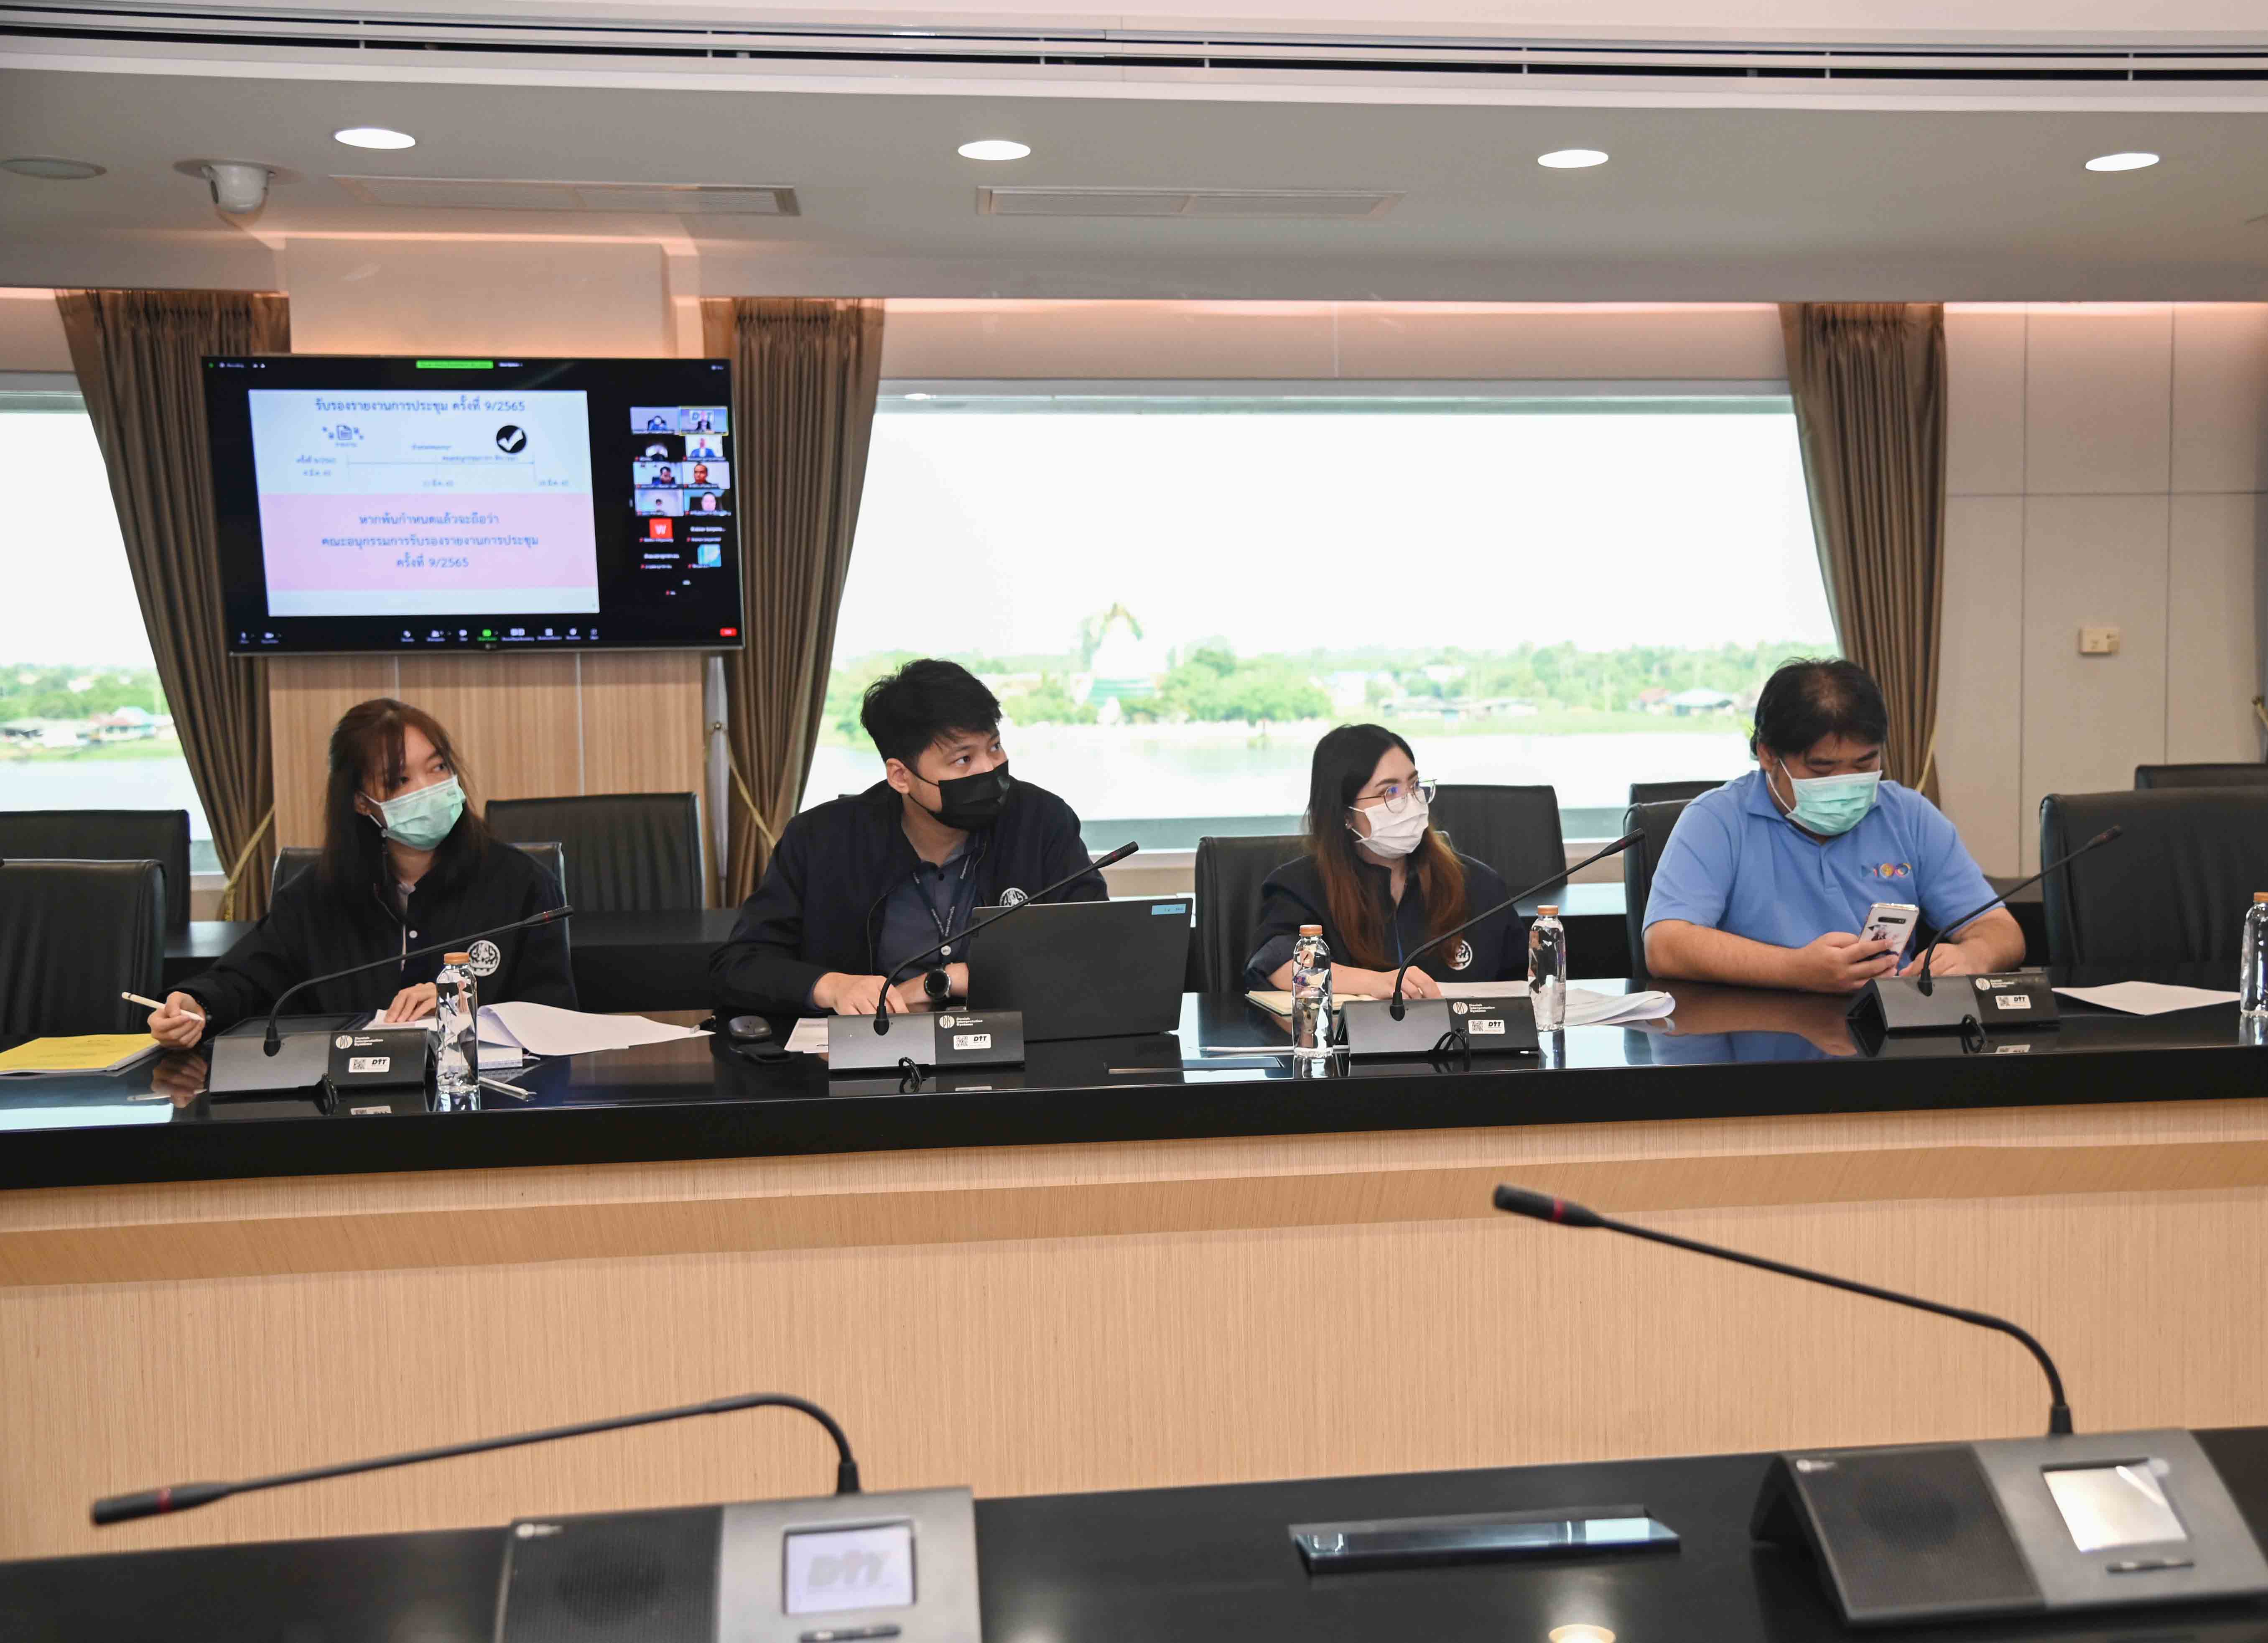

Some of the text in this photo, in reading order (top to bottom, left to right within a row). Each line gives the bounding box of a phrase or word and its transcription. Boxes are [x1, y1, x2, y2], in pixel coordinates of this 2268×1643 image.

[315, 394, 525, 414] รับรองรายงานการประชุม ครั้งที่ 9/2565
[655, 524, 667, 535] W
[396, 552, 469, 568] ครั้งที่ 9/2565
